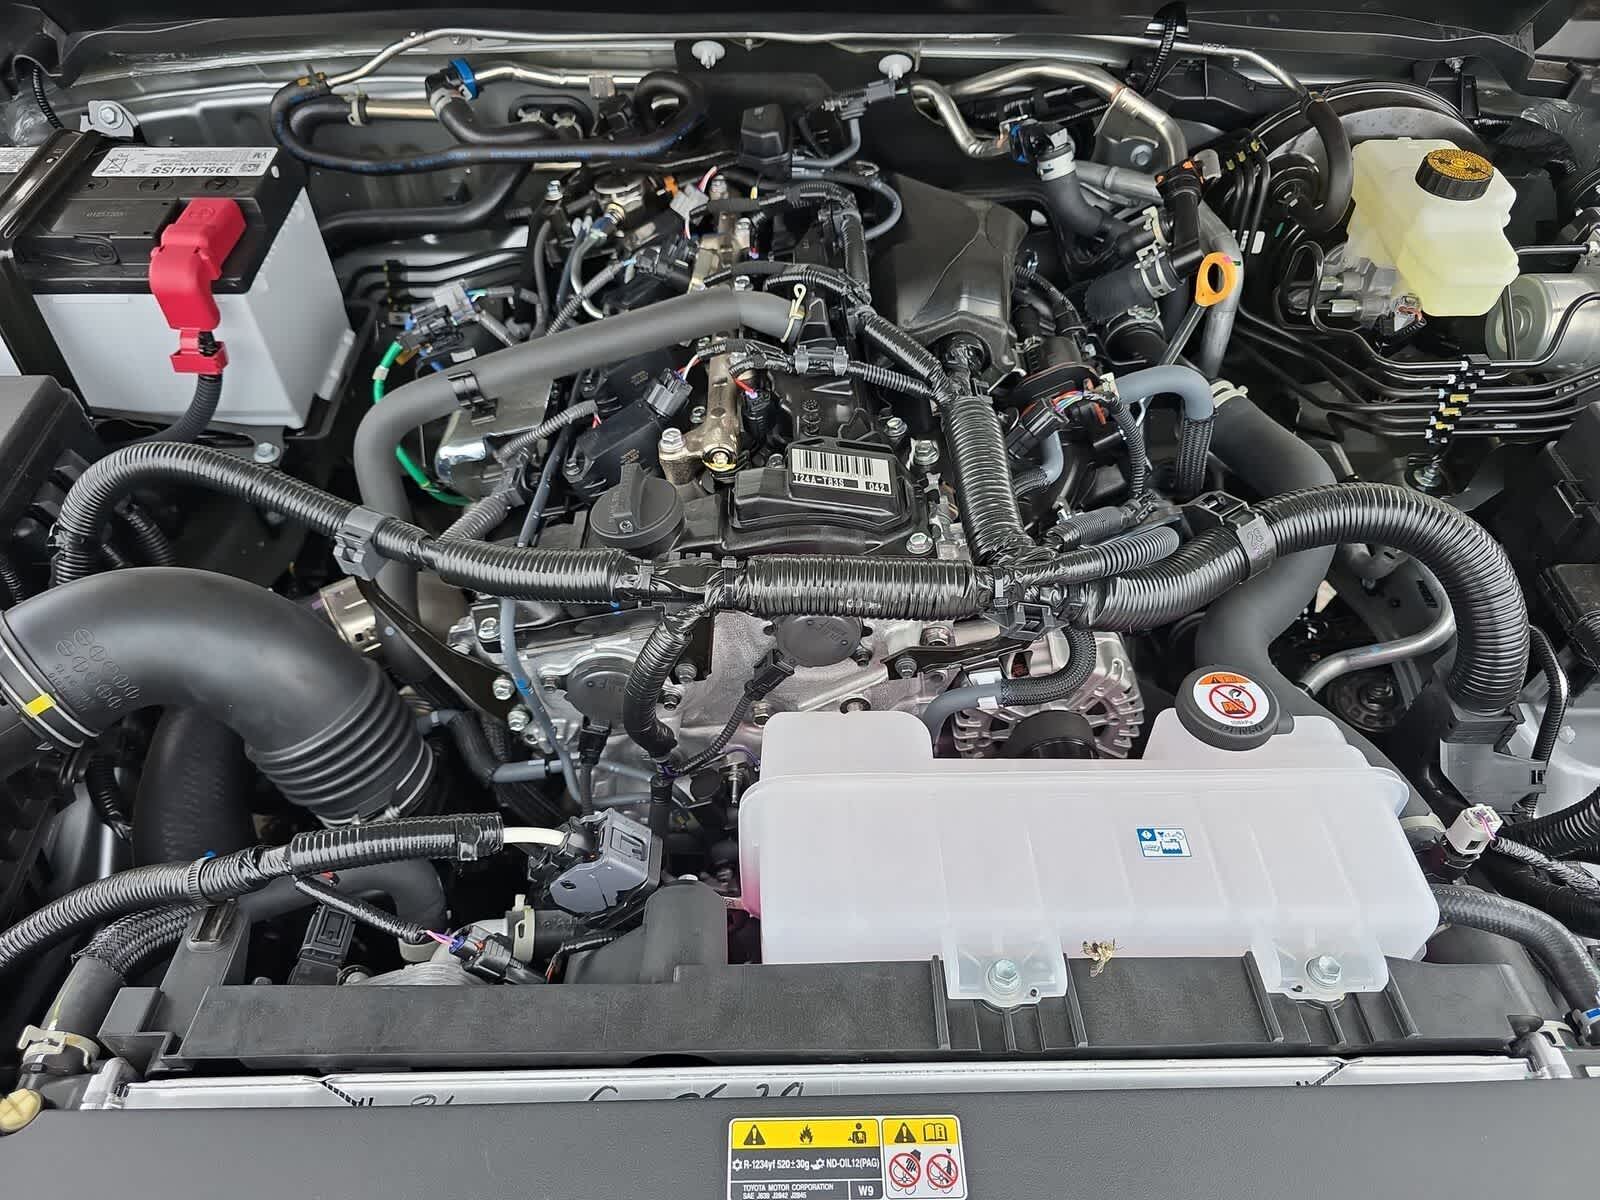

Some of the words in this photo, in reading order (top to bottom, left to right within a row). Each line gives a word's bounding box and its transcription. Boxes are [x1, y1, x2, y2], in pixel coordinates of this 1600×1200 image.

[151, 166, 233, 174] 395LN4-ISS
[743, 1159, 776, 1171] R-1234yf
[776, 1159, 810, 1171] 520±30g
[826, 1158, 880, 1169] ND-OIL12(PAG)
[792, 1183, 834, 1191] CORPORATION
[858, 1185, 875, 1197] W9
